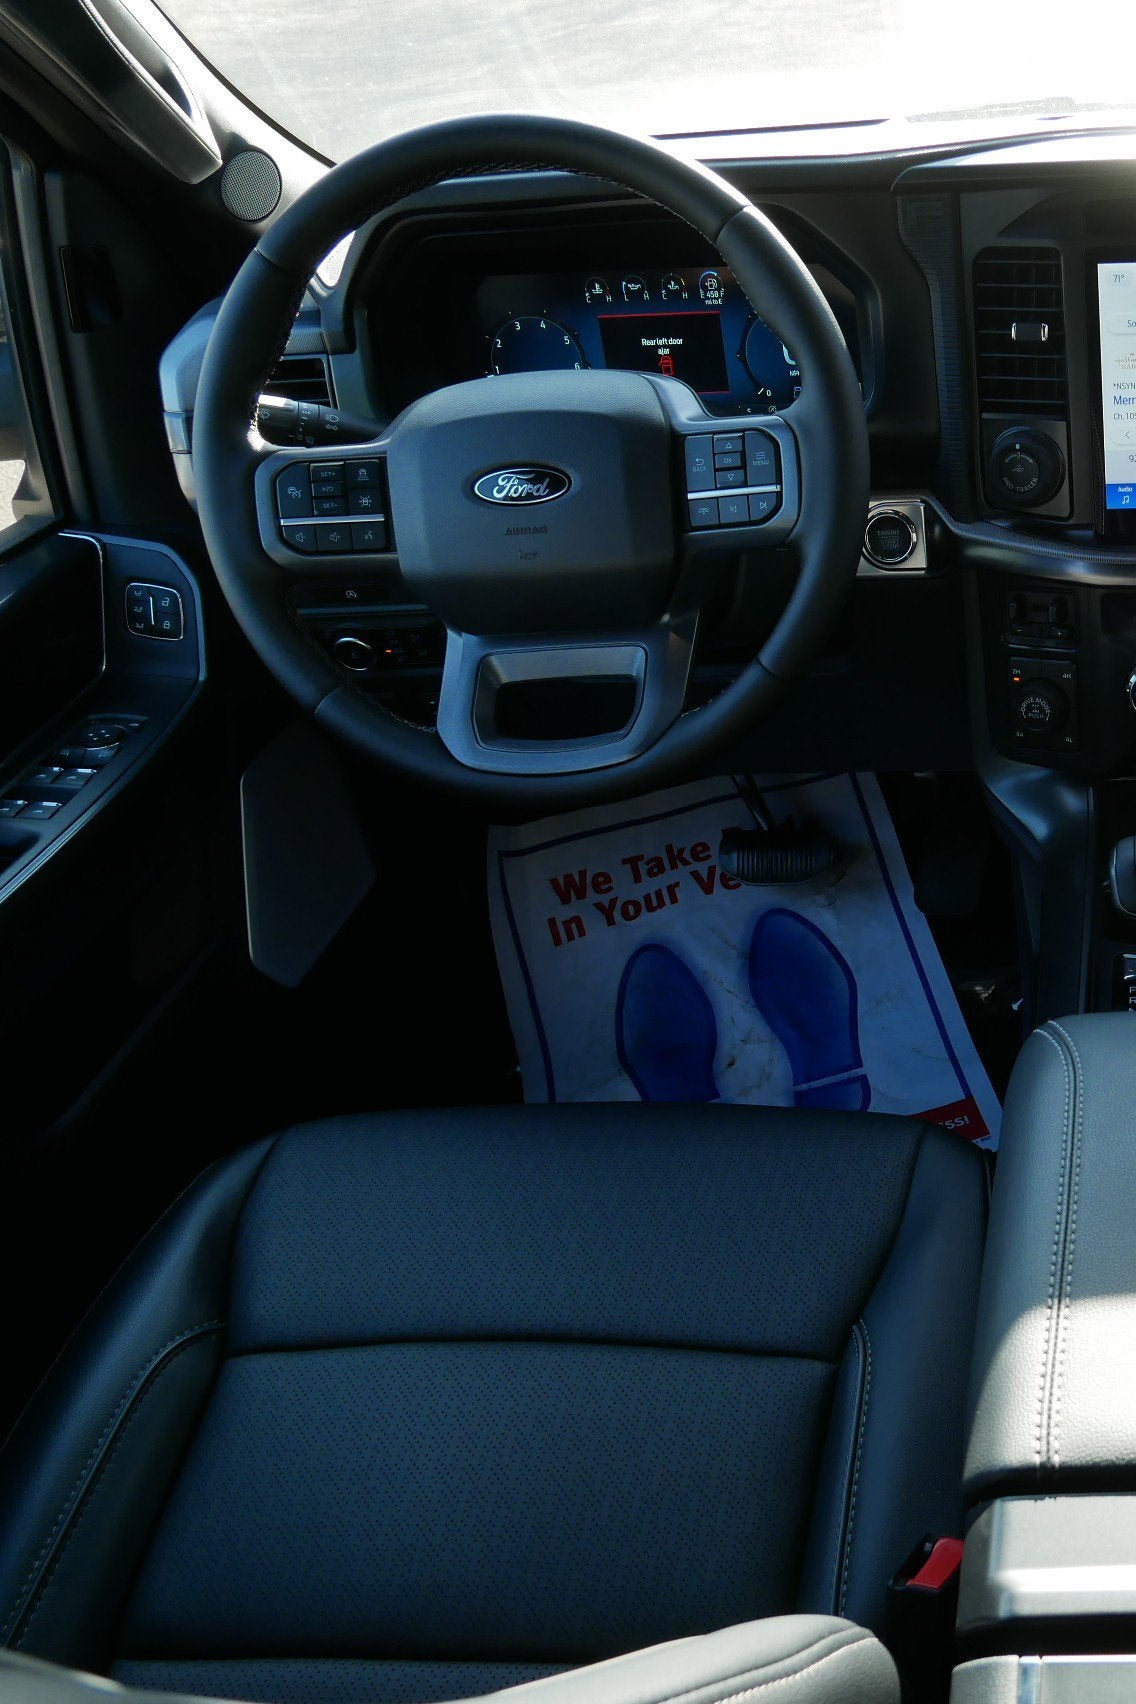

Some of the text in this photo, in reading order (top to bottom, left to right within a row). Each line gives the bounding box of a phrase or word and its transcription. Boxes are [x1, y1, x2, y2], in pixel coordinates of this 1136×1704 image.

[1113, 274, 1125, 283] 71°
[706, 290, 719, 298] 458
[514, 322, 521, 331] 3
[540, 320, 546, 329] 4
[496, 338, 502, 348] 2
[564, 336, 570, 345] 5
[641, 336, 684, 346] Rear left door
[658, 348, 670, 356] ajar
[495, 366, 500, 375] 1
[574, 362, 581, 370] 6
[1113, 412, 1124, 420] Ch.
[492, 473, 550, 499] Ford
[1020, 697, 1035, 712] DRIVE
[549, 841, 713, 906] We Take
[547, 915, 587, 948] In
[592, 881, 681, 927] Your
